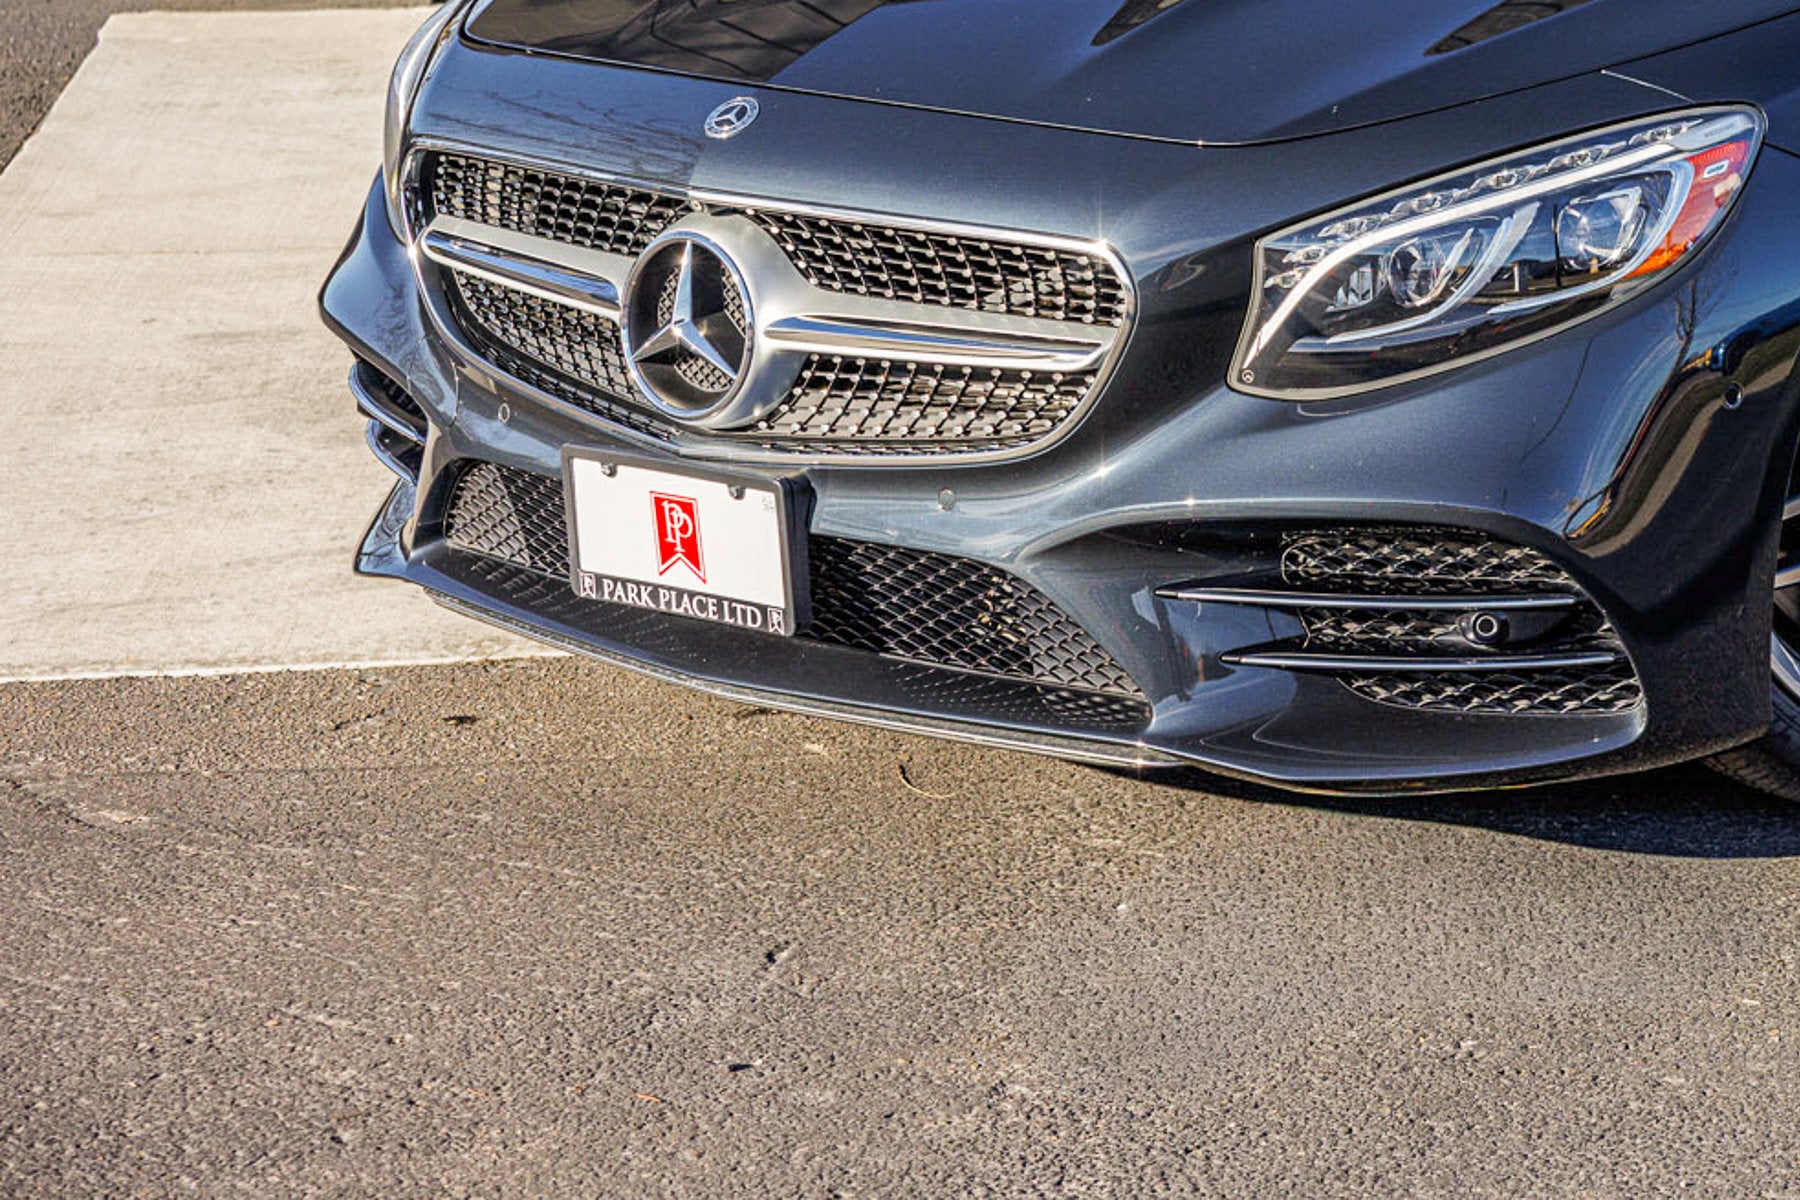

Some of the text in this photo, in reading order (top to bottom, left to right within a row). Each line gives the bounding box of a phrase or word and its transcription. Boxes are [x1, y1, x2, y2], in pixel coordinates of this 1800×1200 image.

[602, 578, 656, 608] PARK
[658, 588, 719, 620] PLACE
[722, 600, 762, 628] LTD
